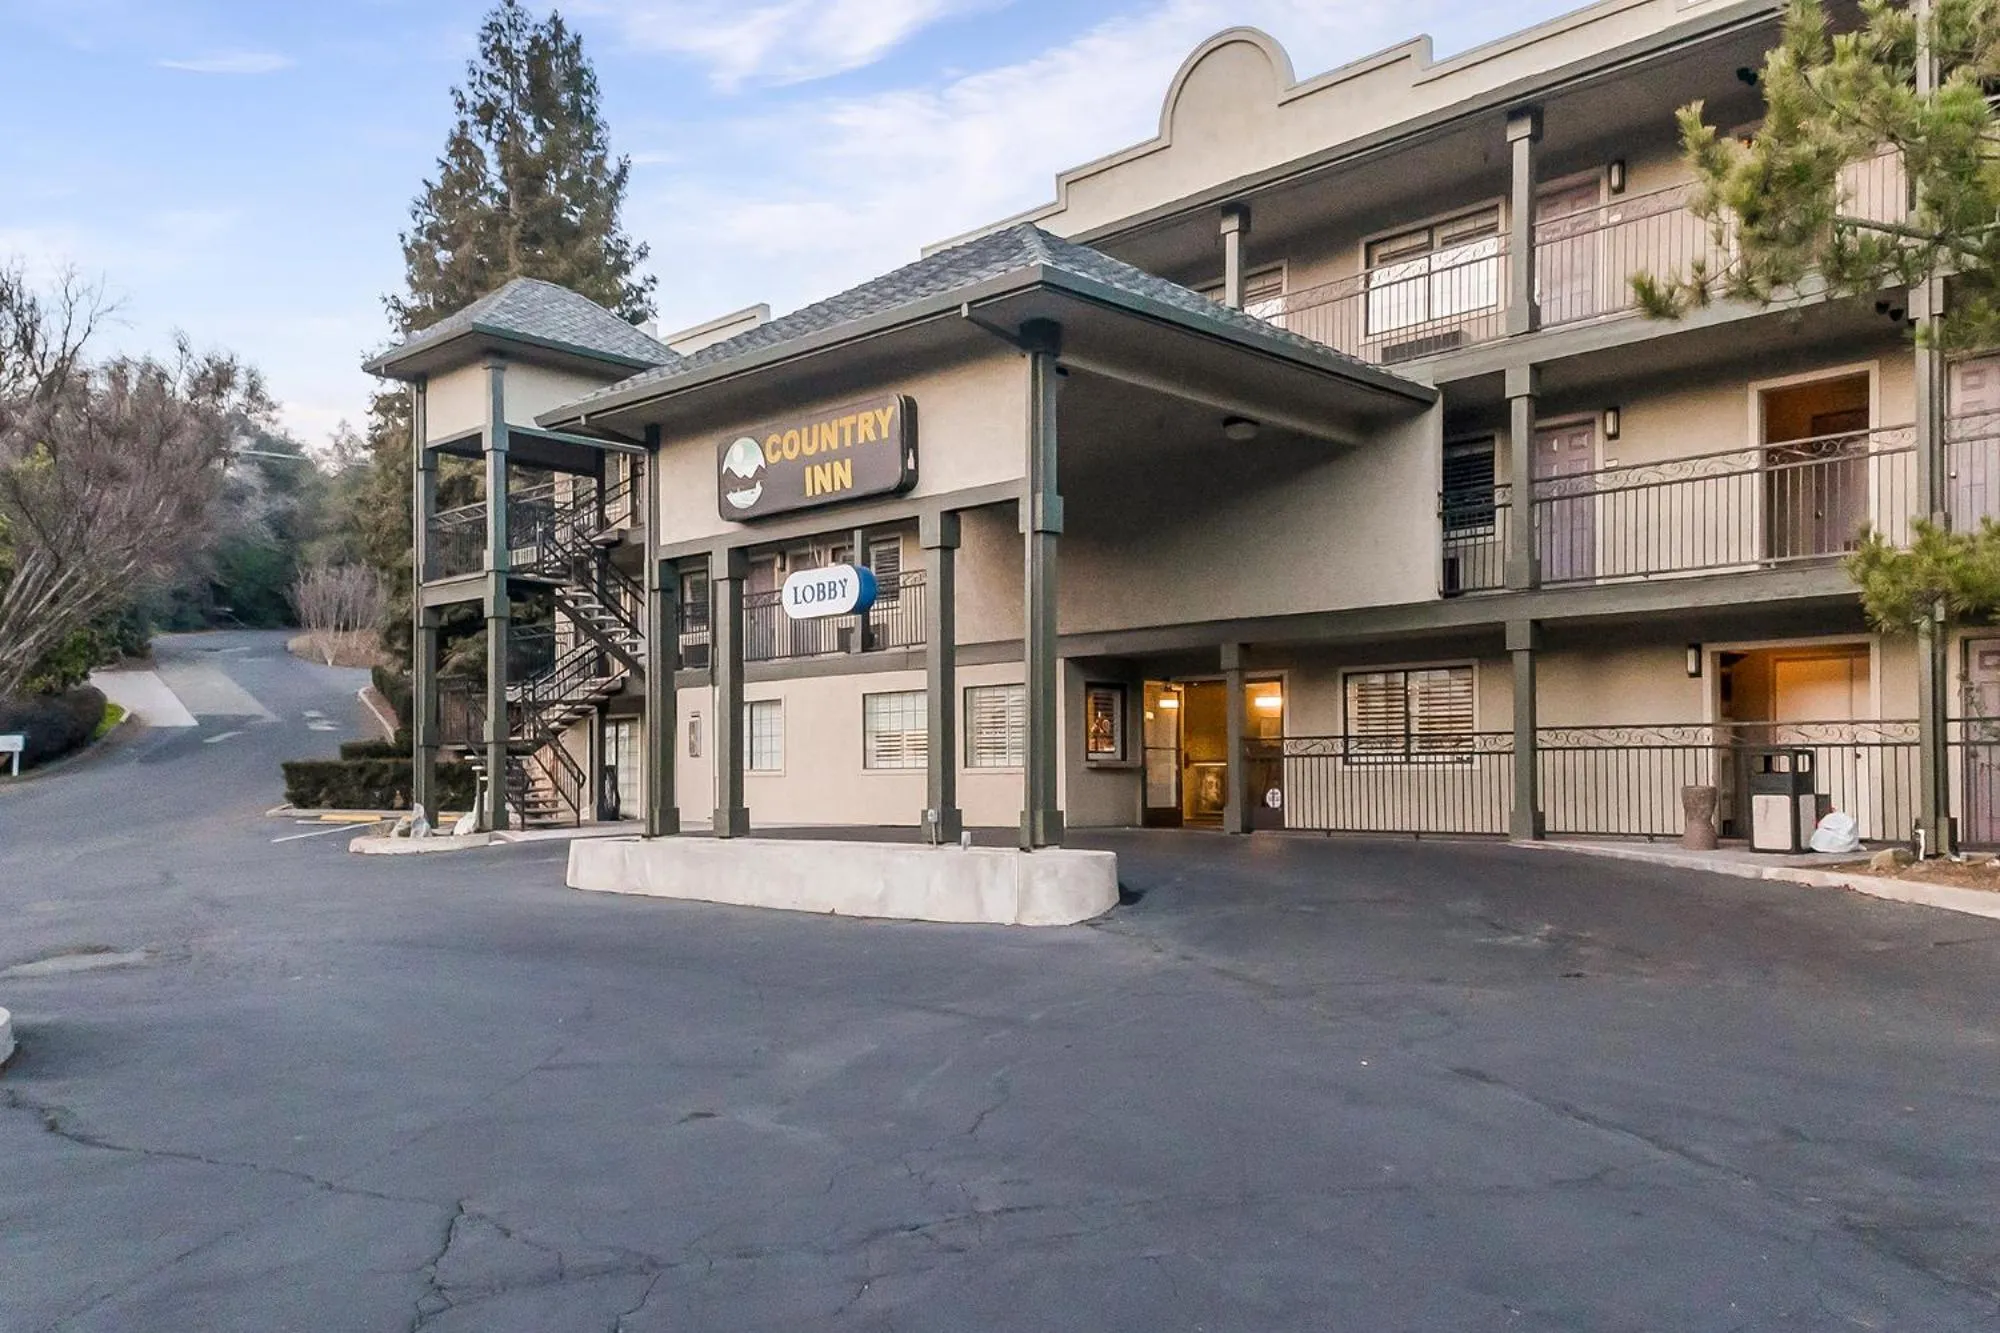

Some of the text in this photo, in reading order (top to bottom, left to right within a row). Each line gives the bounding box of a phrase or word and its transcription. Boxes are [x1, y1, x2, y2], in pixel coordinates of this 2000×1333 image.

[765, 407, 894, 464] COUNTRY
[805, 459, 852, 497] INN
[793, 578, 848, 605] LOBBY
